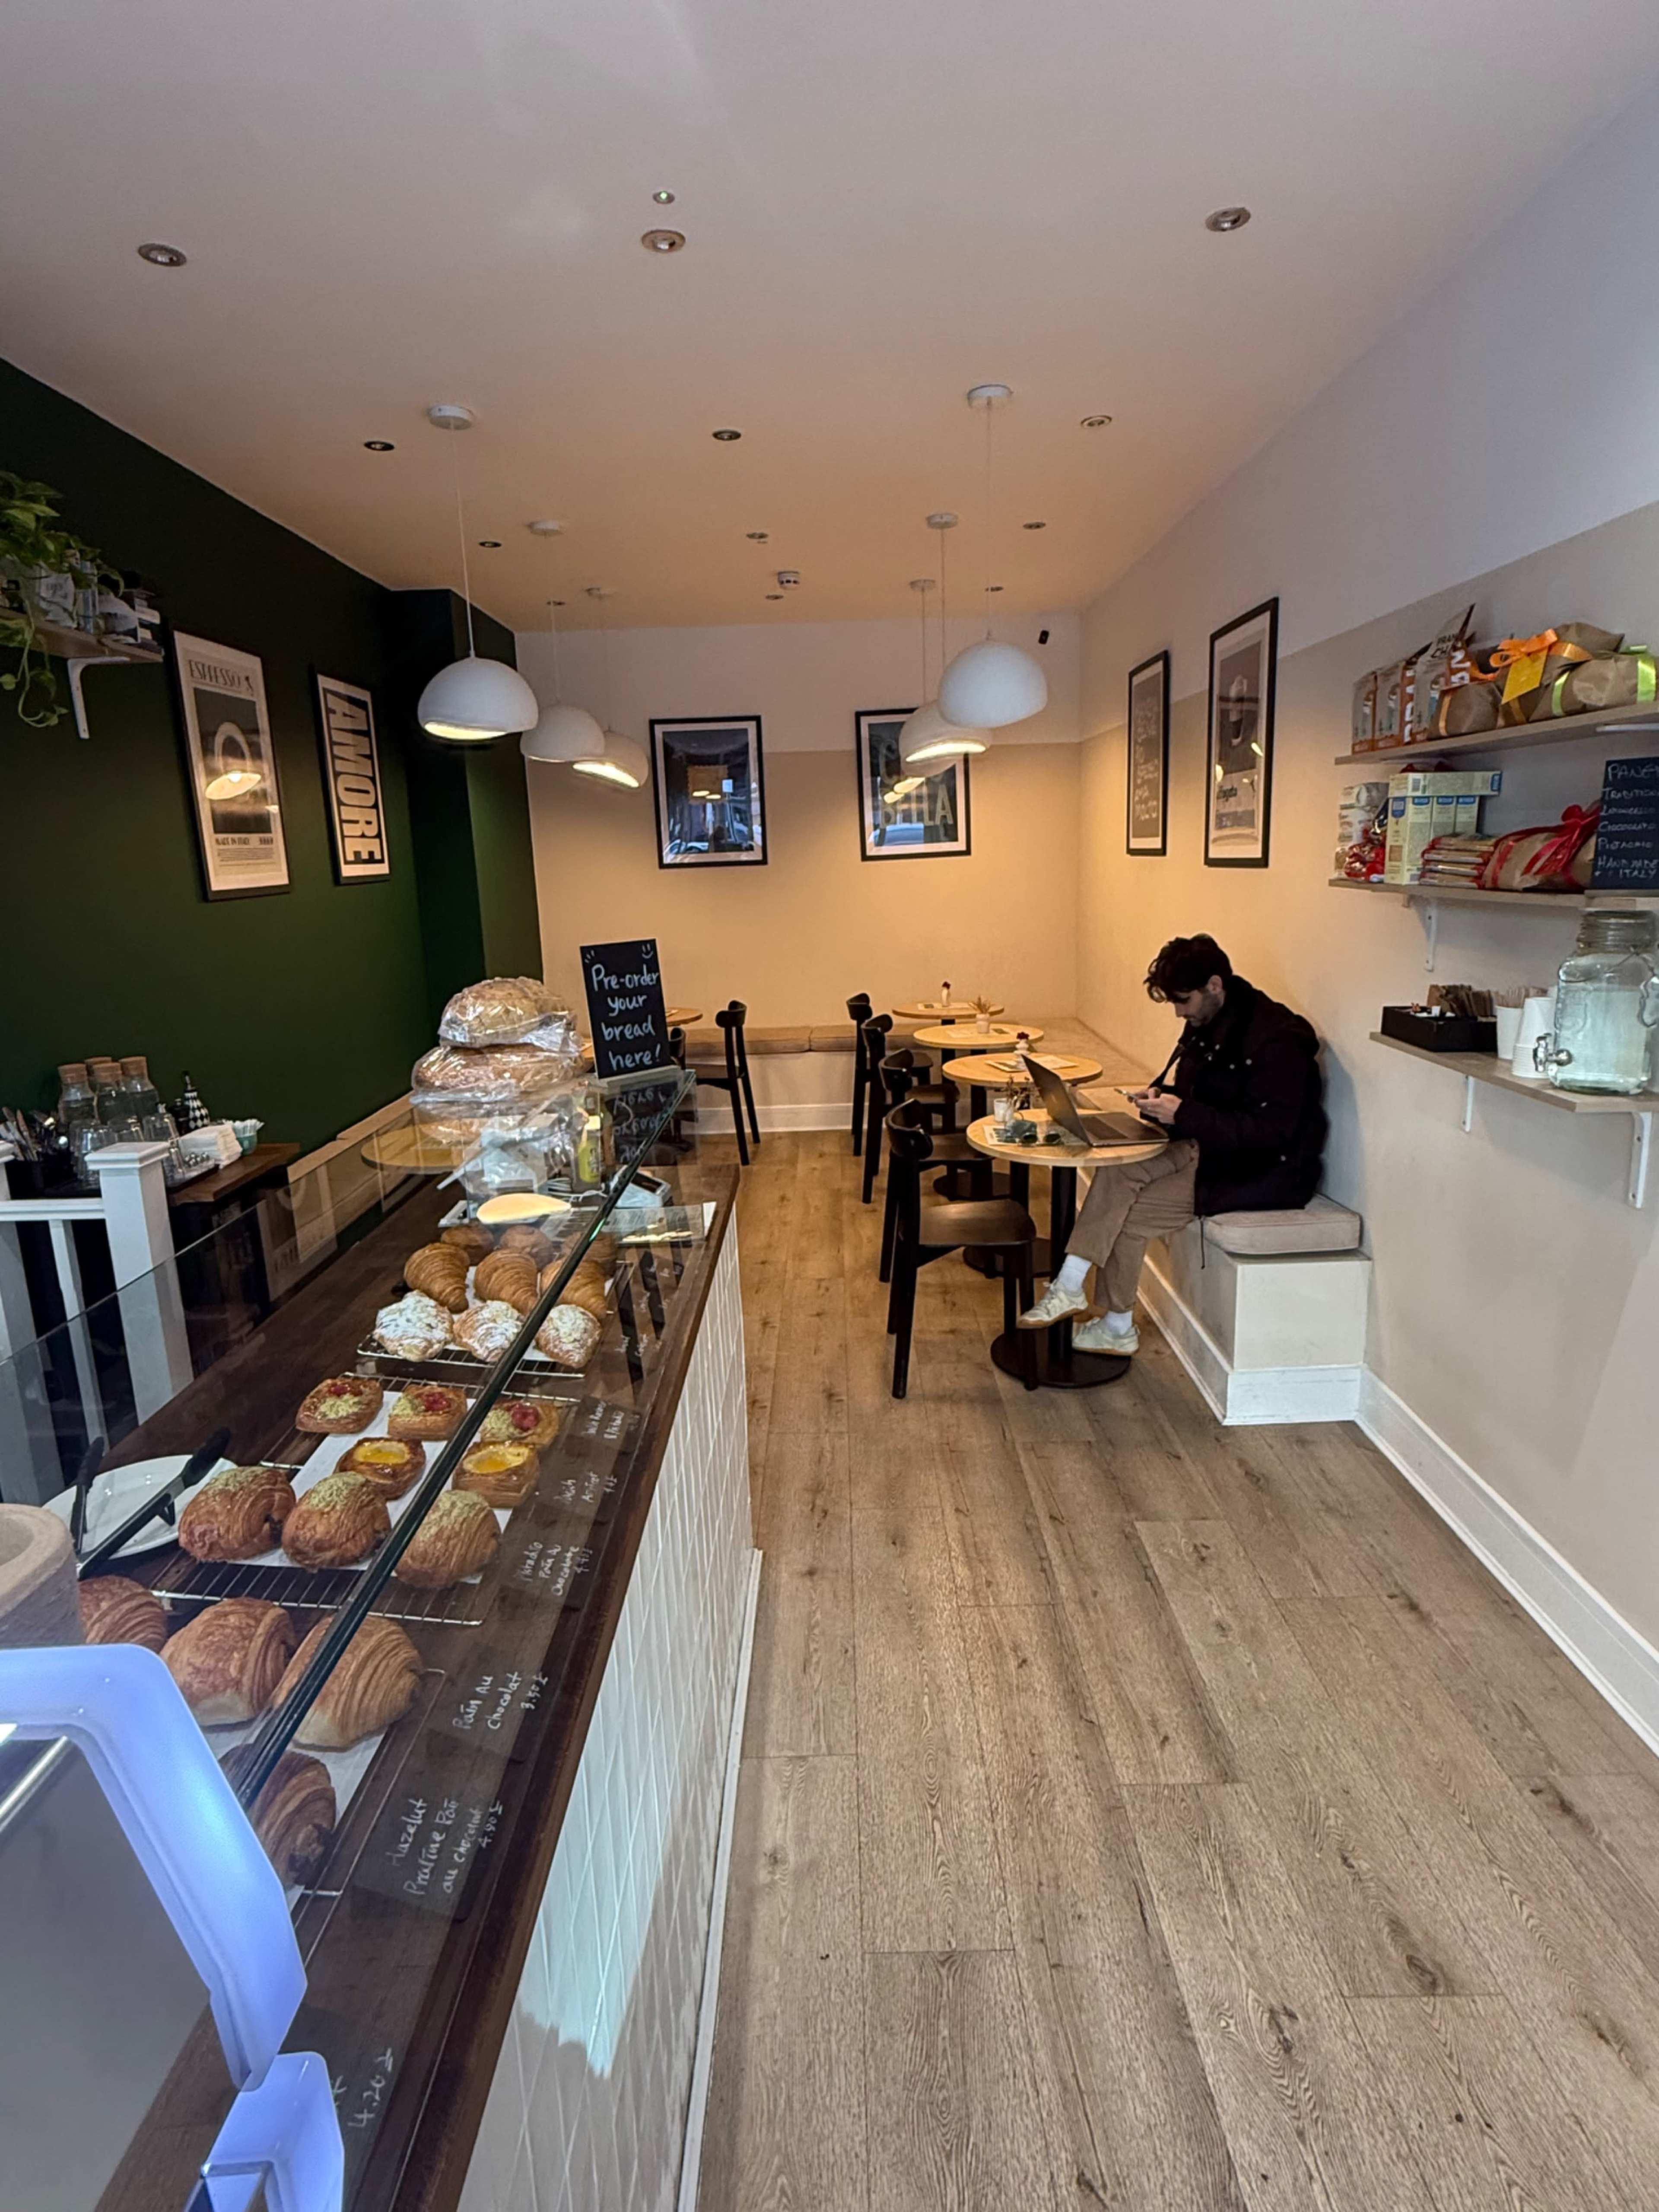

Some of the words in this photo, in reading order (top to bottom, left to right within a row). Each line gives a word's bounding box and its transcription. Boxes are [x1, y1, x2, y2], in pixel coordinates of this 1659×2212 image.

[325, 692, 382, 862] AMORE
[1619, 868, 1657, 880] ITALY
[591, 963, 660, 992] Pre-order
[607, 994, 648, 1017] your
[601, 1014, 655, 1042] bread
[609, 1043, 661, 1071] here!
